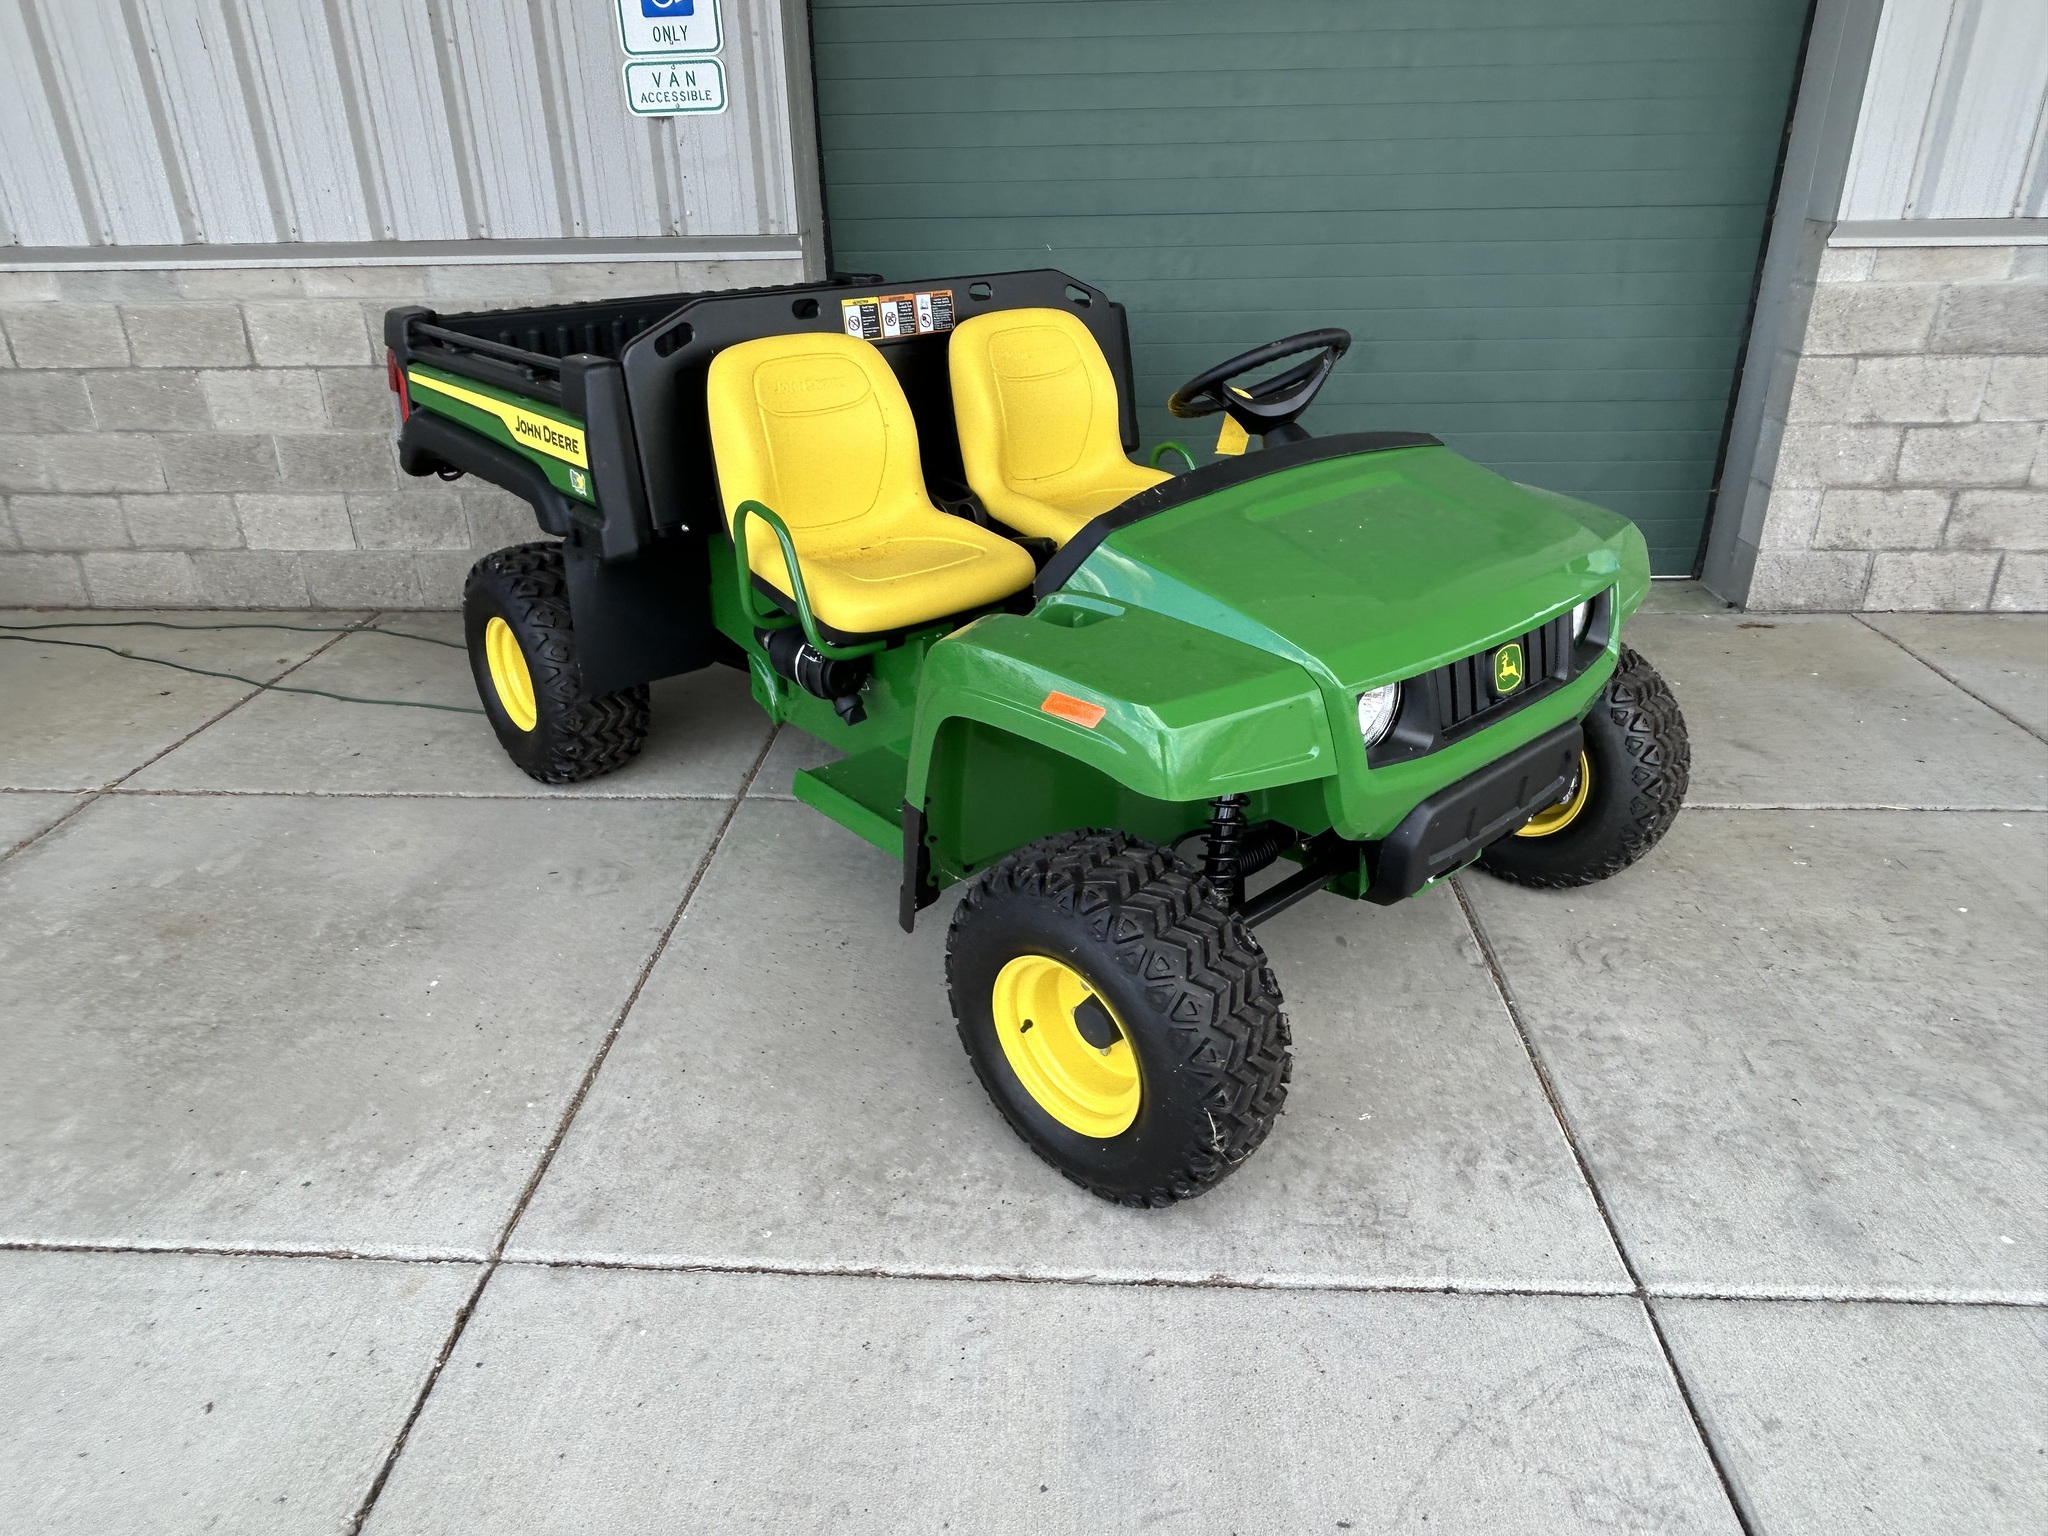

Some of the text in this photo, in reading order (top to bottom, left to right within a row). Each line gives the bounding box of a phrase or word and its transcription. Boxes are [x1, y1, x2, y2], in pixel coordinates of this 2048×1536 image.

[652, 25, 688, 42] ONLY
[652, 70, 696, 88] VAN
[640, 90, 712, 103] ACCESSIBLE
[515, 415, 579, 454] JOHN DEERE
